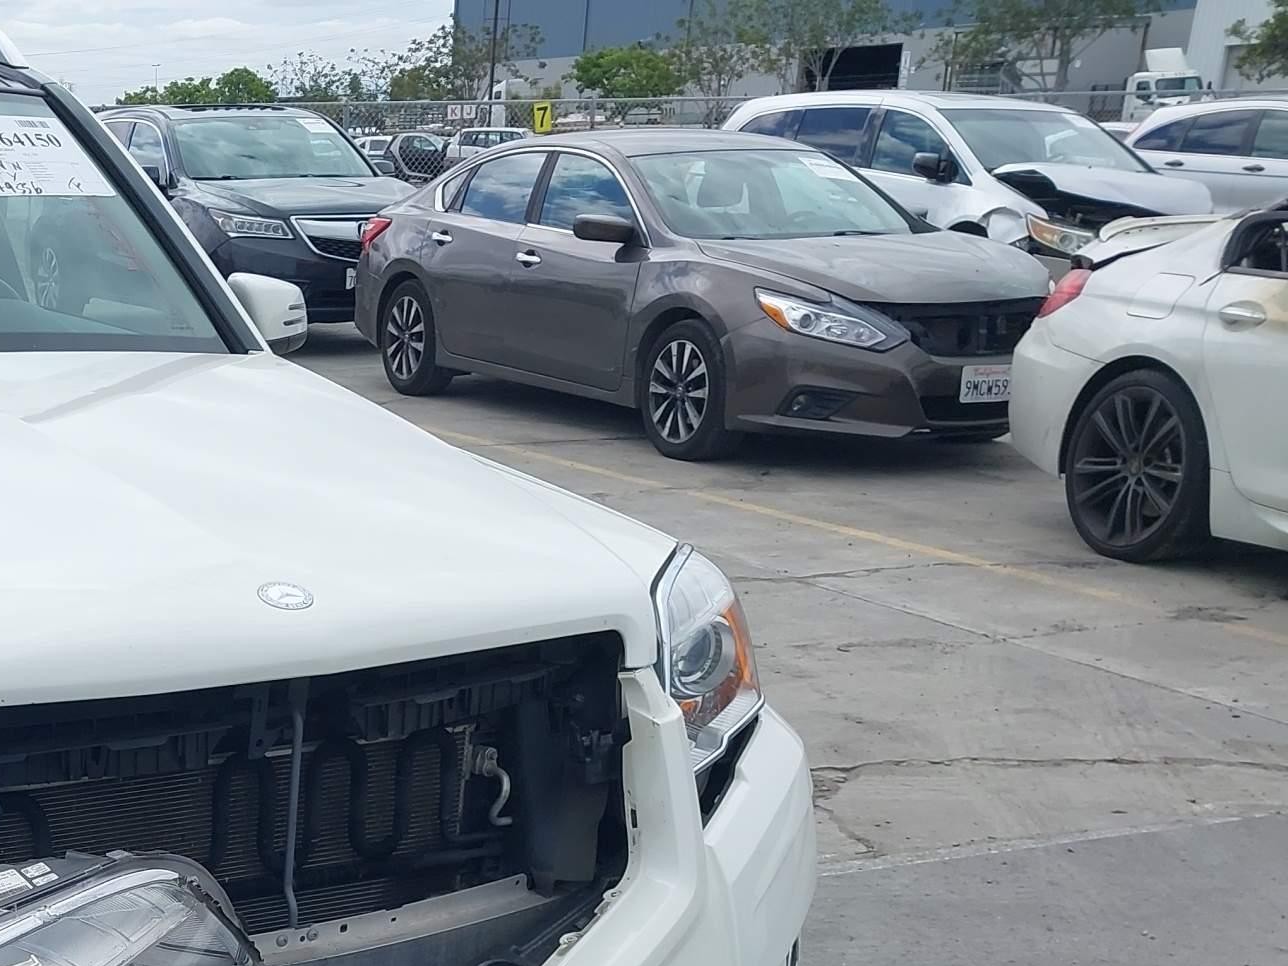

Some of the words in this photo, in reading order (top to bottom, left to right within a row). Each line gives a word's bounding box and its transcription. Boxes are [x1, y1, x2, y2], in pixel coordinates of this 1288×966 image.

[450, 106, 458, 117] K
[536, 105, 549, 129] 7
[964, 378, 1011, 397] 9MCW59
